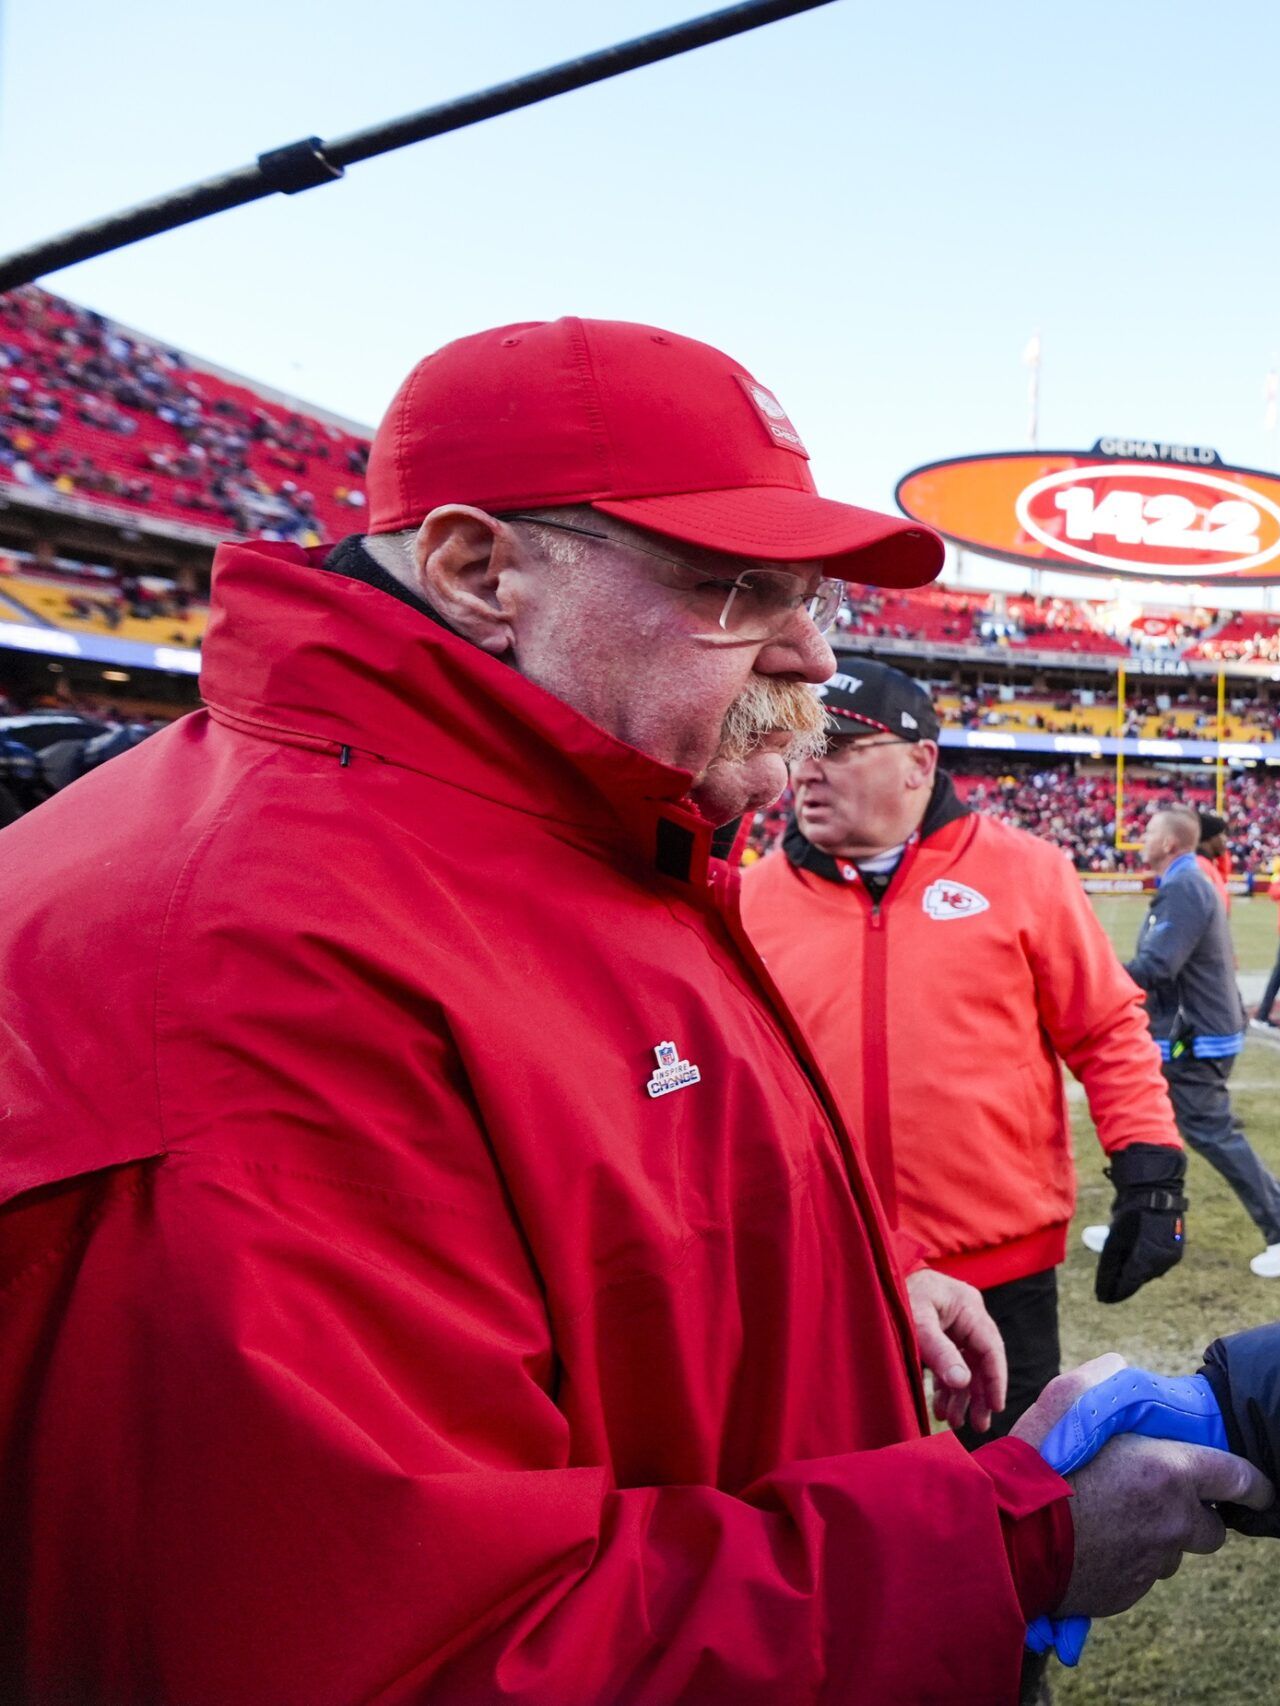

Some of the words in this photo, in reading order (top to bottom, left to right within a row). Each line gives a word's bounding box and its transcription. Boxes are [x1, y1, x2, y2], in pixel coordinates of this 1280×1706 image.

[1100, 437, 1159, 460] GEHA
[1160, 444, 1216, 465] FIELD
[650, 1068, 698, 1094] CHANGE
[656, 1063, 688, 1080] INSPIRE
